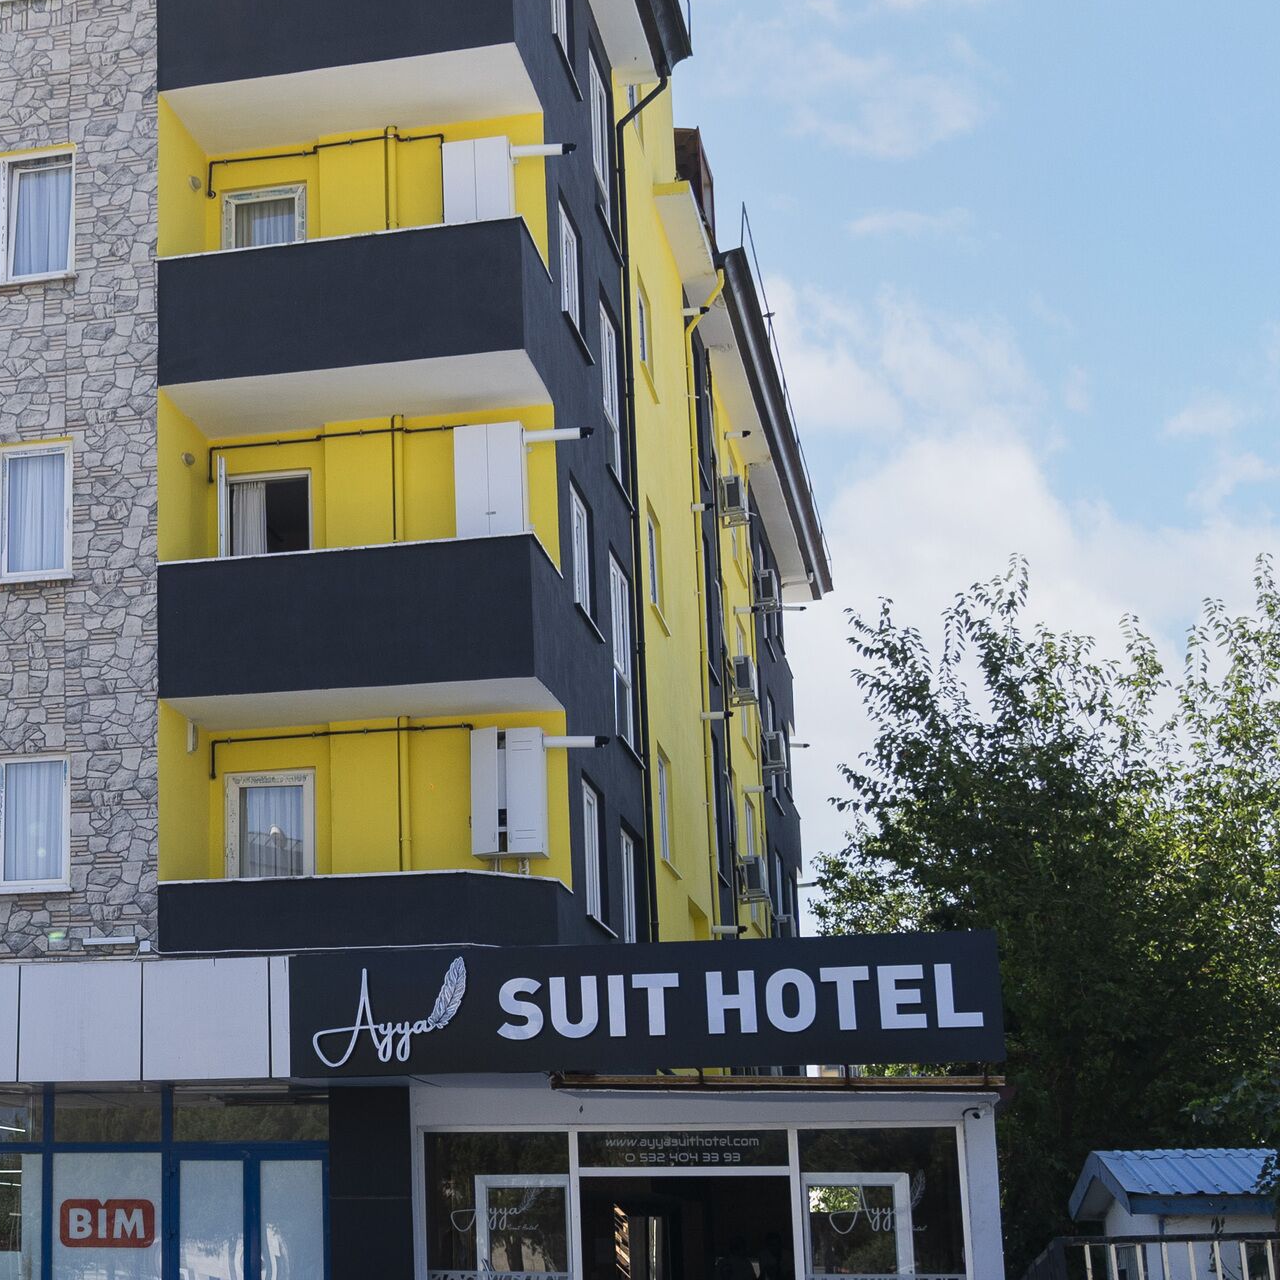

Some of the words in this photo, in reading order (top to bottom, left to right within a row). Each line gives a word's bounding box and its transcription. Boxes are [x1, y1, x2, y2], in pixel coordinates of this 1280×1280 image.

[312, 968, 433, 1068] Ayya
[496, 972, 680, 1041] SUIT
[705, 963, 984, 1034] HOTEL
[605, 1135, 760, 1150] www.ayyasuithotel.com
[639, 1152, 666, 1163] 532
[669, 1152, 699, 1163] 404
[702, 1152, 720, 1163] 33
[723, 1152, 741, 1163] 93
